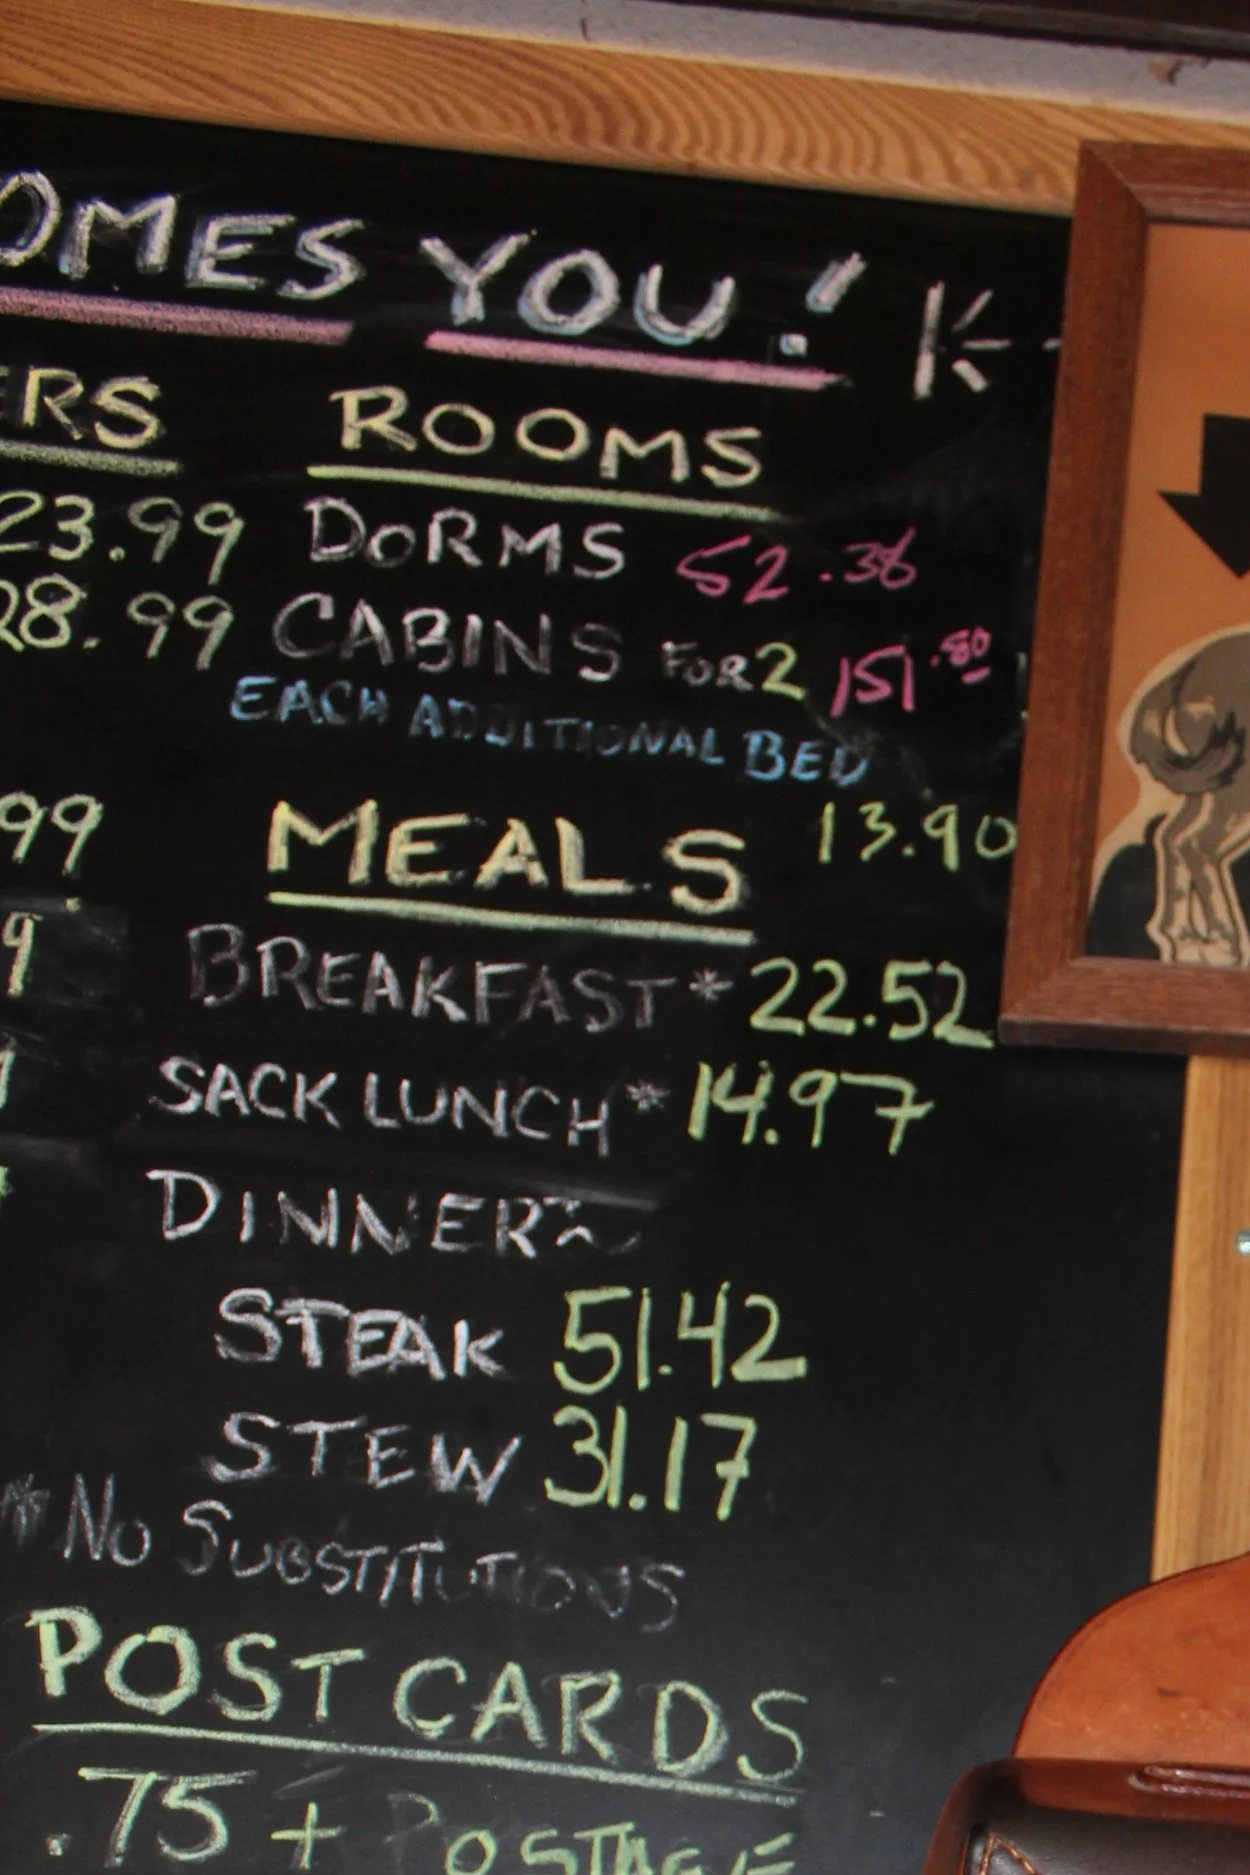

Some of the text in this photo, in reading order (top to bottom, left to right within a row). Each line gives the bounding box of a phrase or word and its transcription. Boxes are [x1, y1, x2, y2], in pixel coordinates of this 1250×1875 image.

[0, 365, 168, 450] RS
[329, 385, 764, 488] ROOMS
[271, 592, 624, 682] CABINS
[229, 674, 391, 725] EACH
[743, 729, 870, 787] BED
[266, 799, 751, 915] MEALS
[748, 957, 996, 1049] 22.52
[149, 1055, 342, 1130] SACK
[687, 1060, 936, 1156] 14.97
[214, 1280, 809, 1396] STEAK 51.42
[203, 1404, 758, 1521] STEW 31.17
[25, 1605, 811, 1785] POST CARDS
